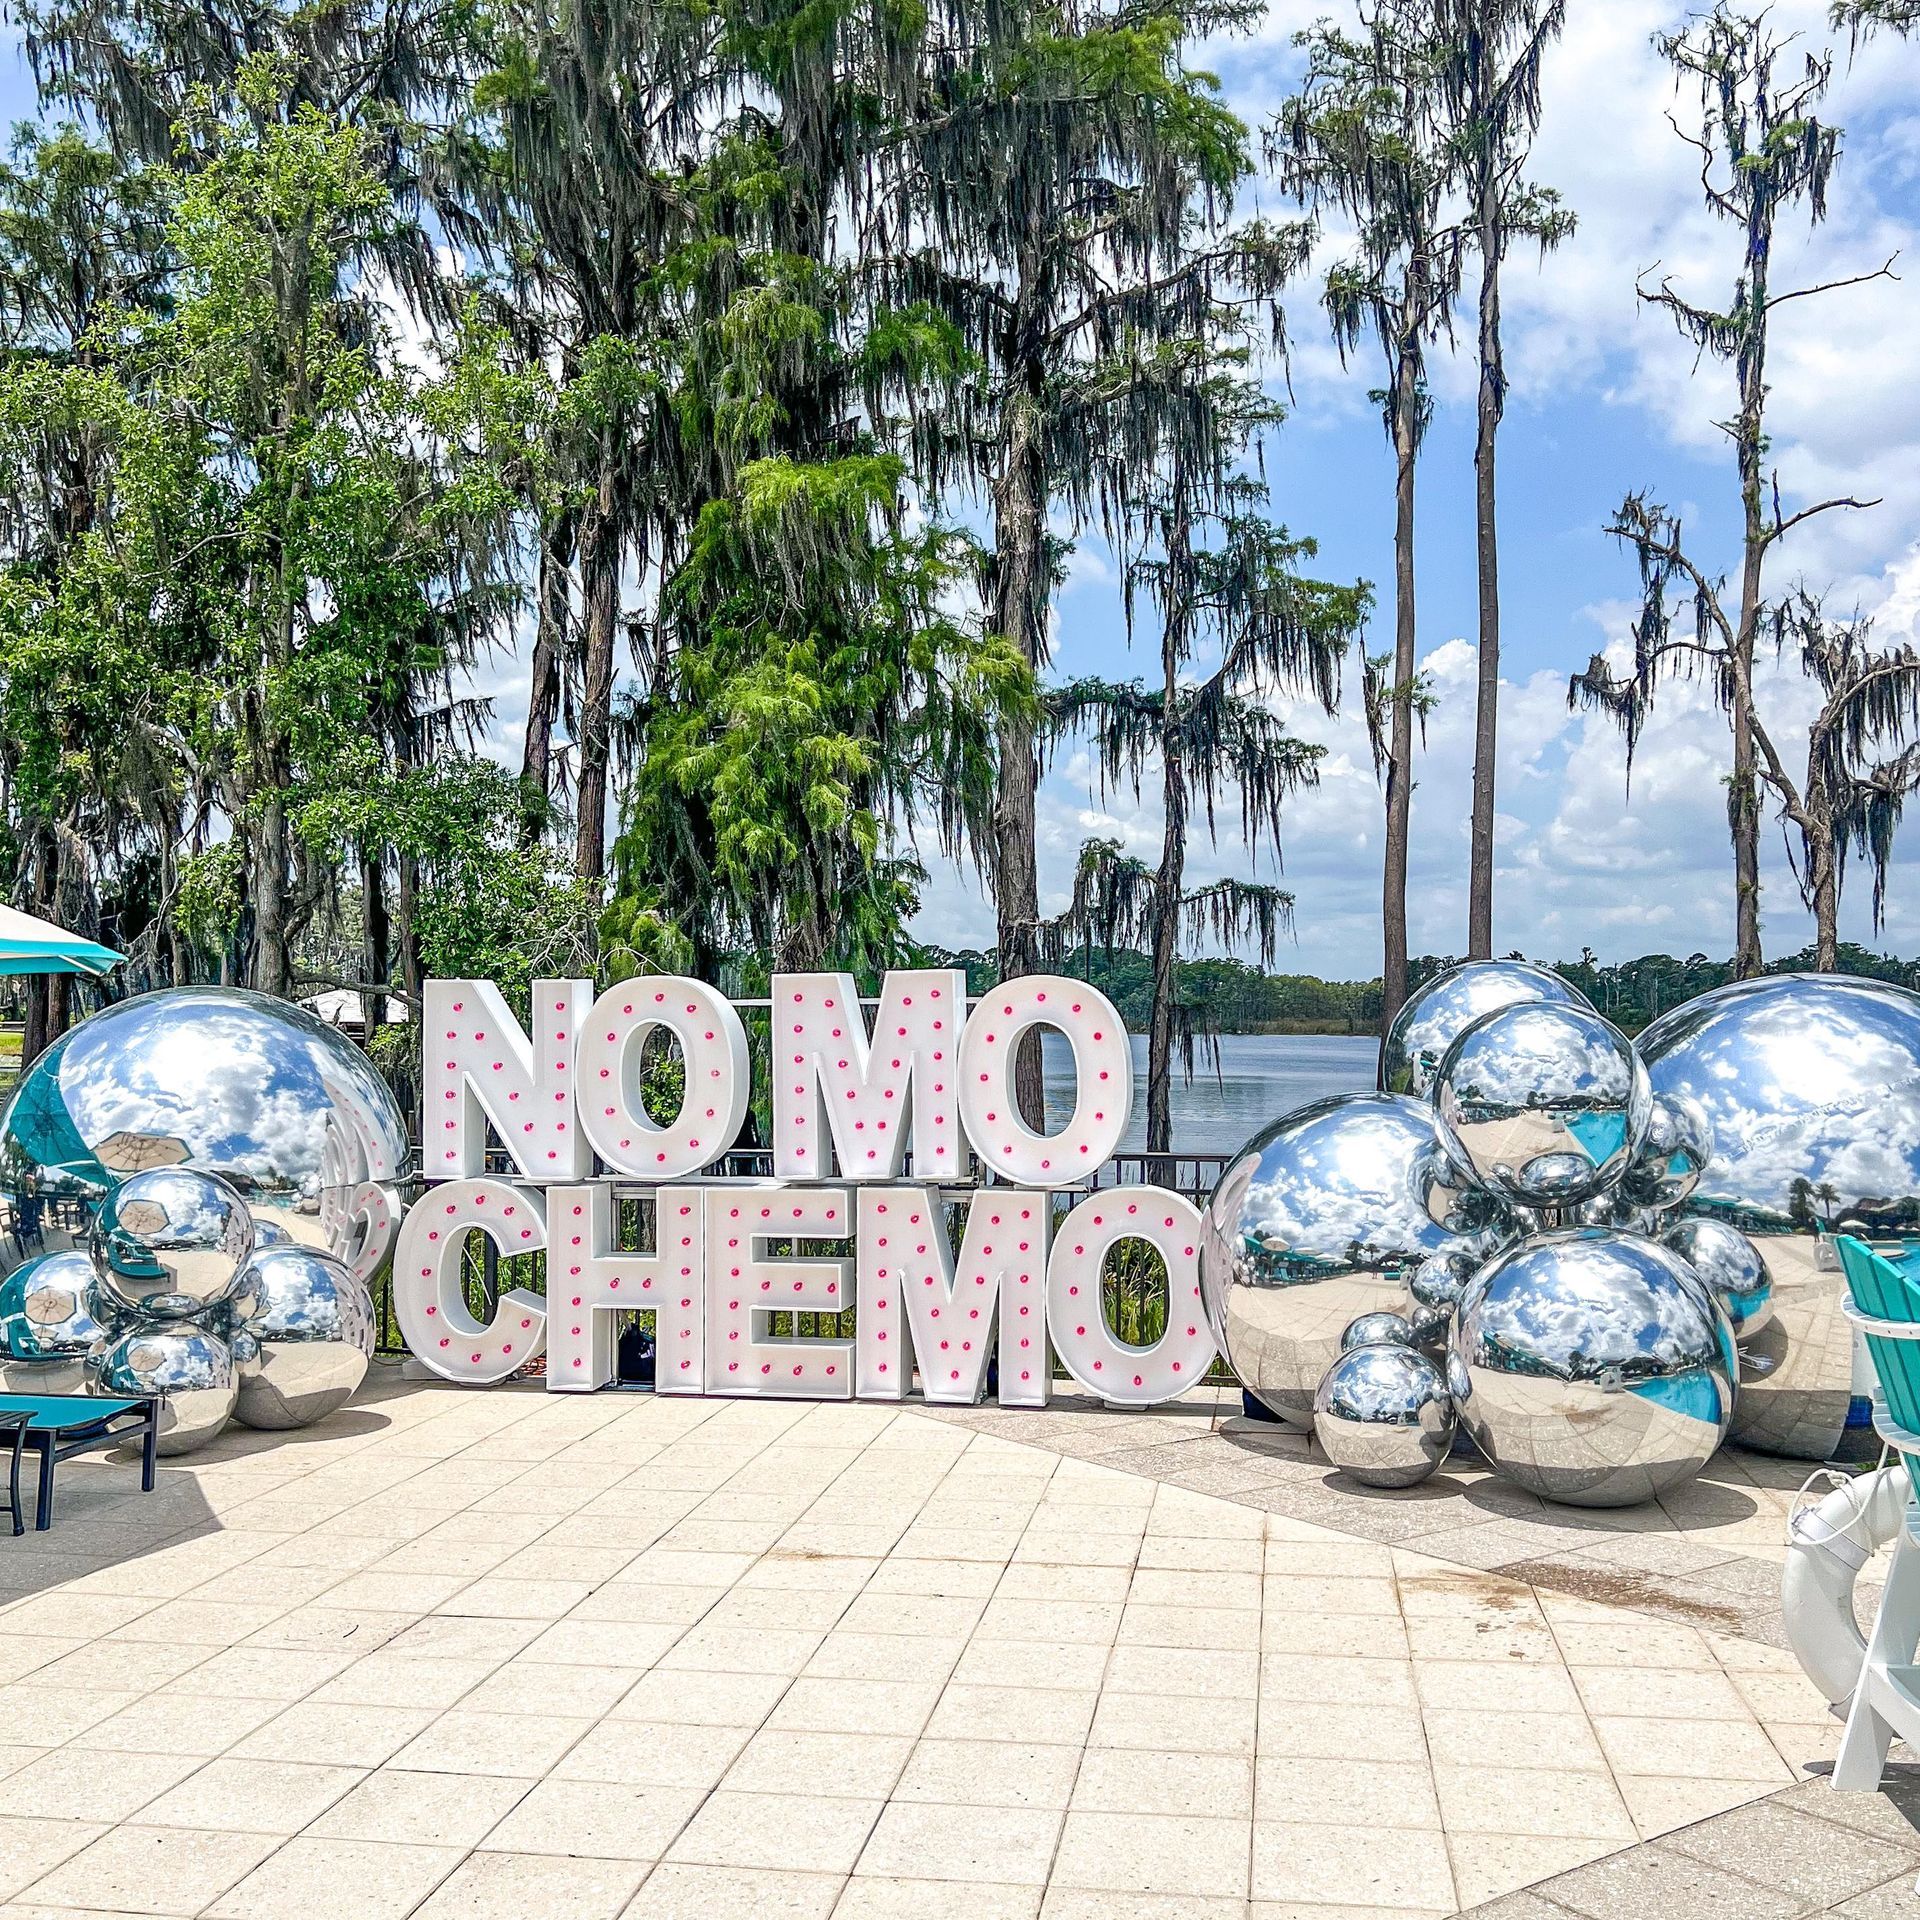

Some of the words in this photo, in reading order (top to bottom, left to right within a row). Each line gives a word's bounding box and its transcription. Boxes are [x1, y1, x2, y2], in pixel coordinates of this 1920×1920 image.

[422, 975, 749, 1179] NO
[772, 969, 1130, 1186] MO
[393, 1179, 1217, 1407] CHEMO
